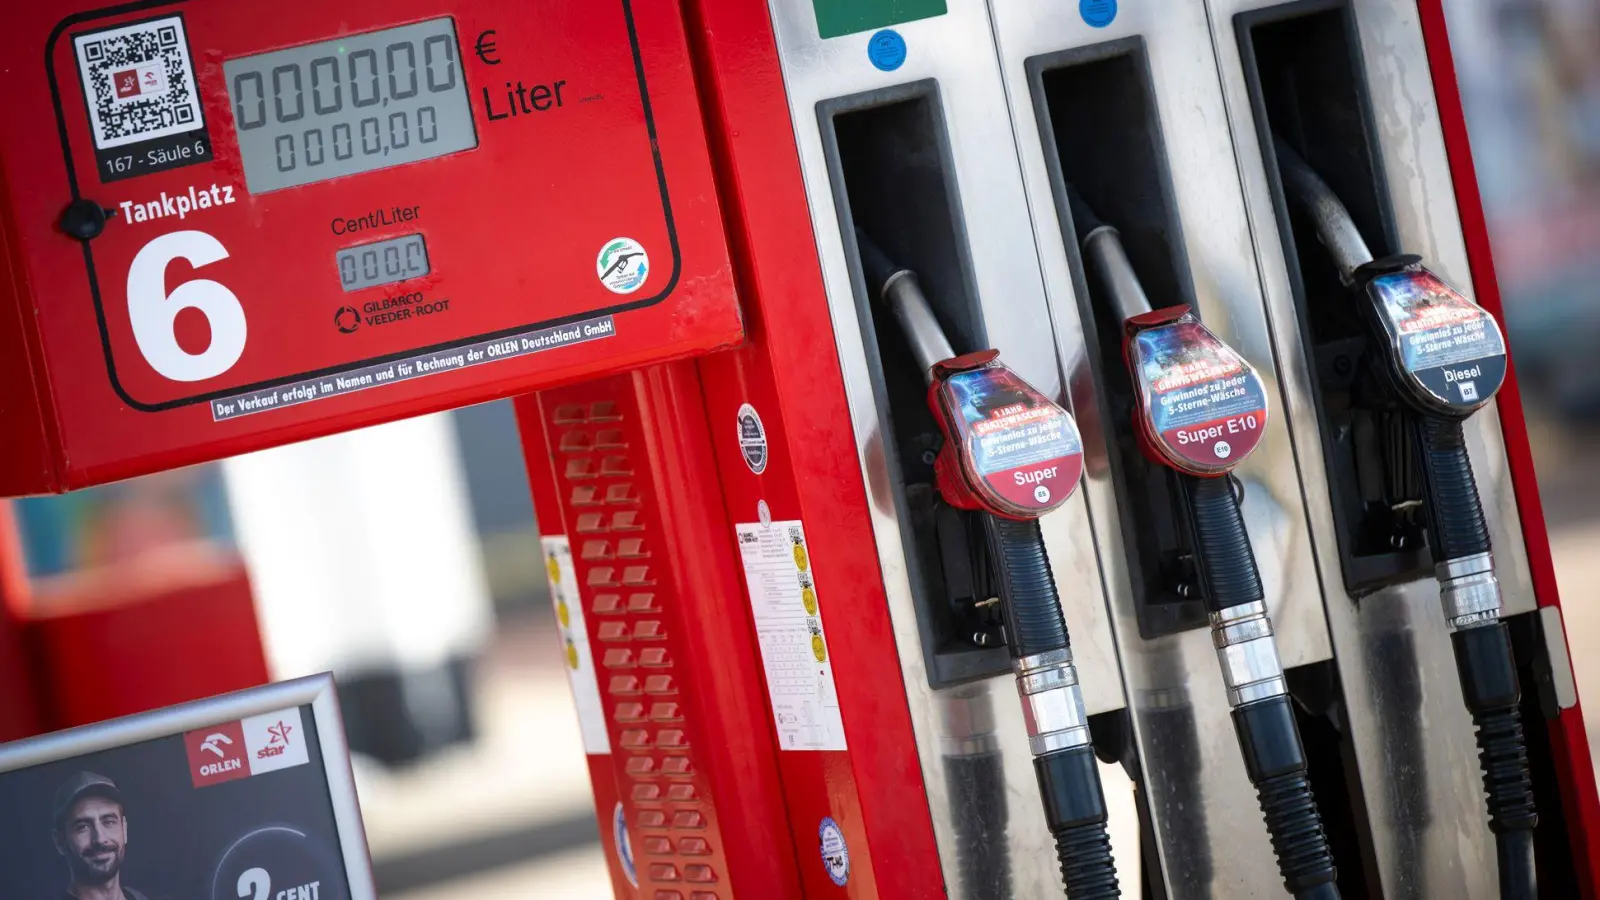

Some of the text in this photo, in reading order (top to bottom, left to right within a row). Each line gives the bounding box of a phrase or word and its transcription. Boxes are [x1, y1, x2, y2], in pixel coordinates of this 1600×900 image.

[474, 29, 501, 65] €
[234, 34, 455, 131] 0000,00
[482, 79, 566, 121] Liter
[275, 106, 438, 173] 0000,00
[106, 155, 133, 174] 167
[147, 144, 191, 166] Säule
[194, 140, 205, 155] 6
[120, 183, 236, 225] Tankplatz
[331, 206, 420, 235] Cent/Liter
[126, 229, 248, 382] 6
[363, 291, 424, 314] GILBARCO
[365, 299, 450, 326] VEEDER-ROOT
[216, 320, 612, 416] Der Verkauf erfolgt im Namen und für Rechnung der ORLEN Deutschland GmbH
[1444, 364, 1481, 382] Diesel
[1160, 375, 1247, 406] Gewinnlos zu jeder
[1168, 387, 1246, 415] 5-Sterne-Wäsche
[1463, 387, 1473, 395] B7
[1027, 424, 1038, 436] zu
[1177, 415, 1257, 445] Super E10
[1216, 444, 1229, 453] E10
[1013, 465, 1058, 486] Super
[257, 744, 285, 759] star
[200, 757, 241, 776] ORLEN
[276, 881, 320, 900] CENT
